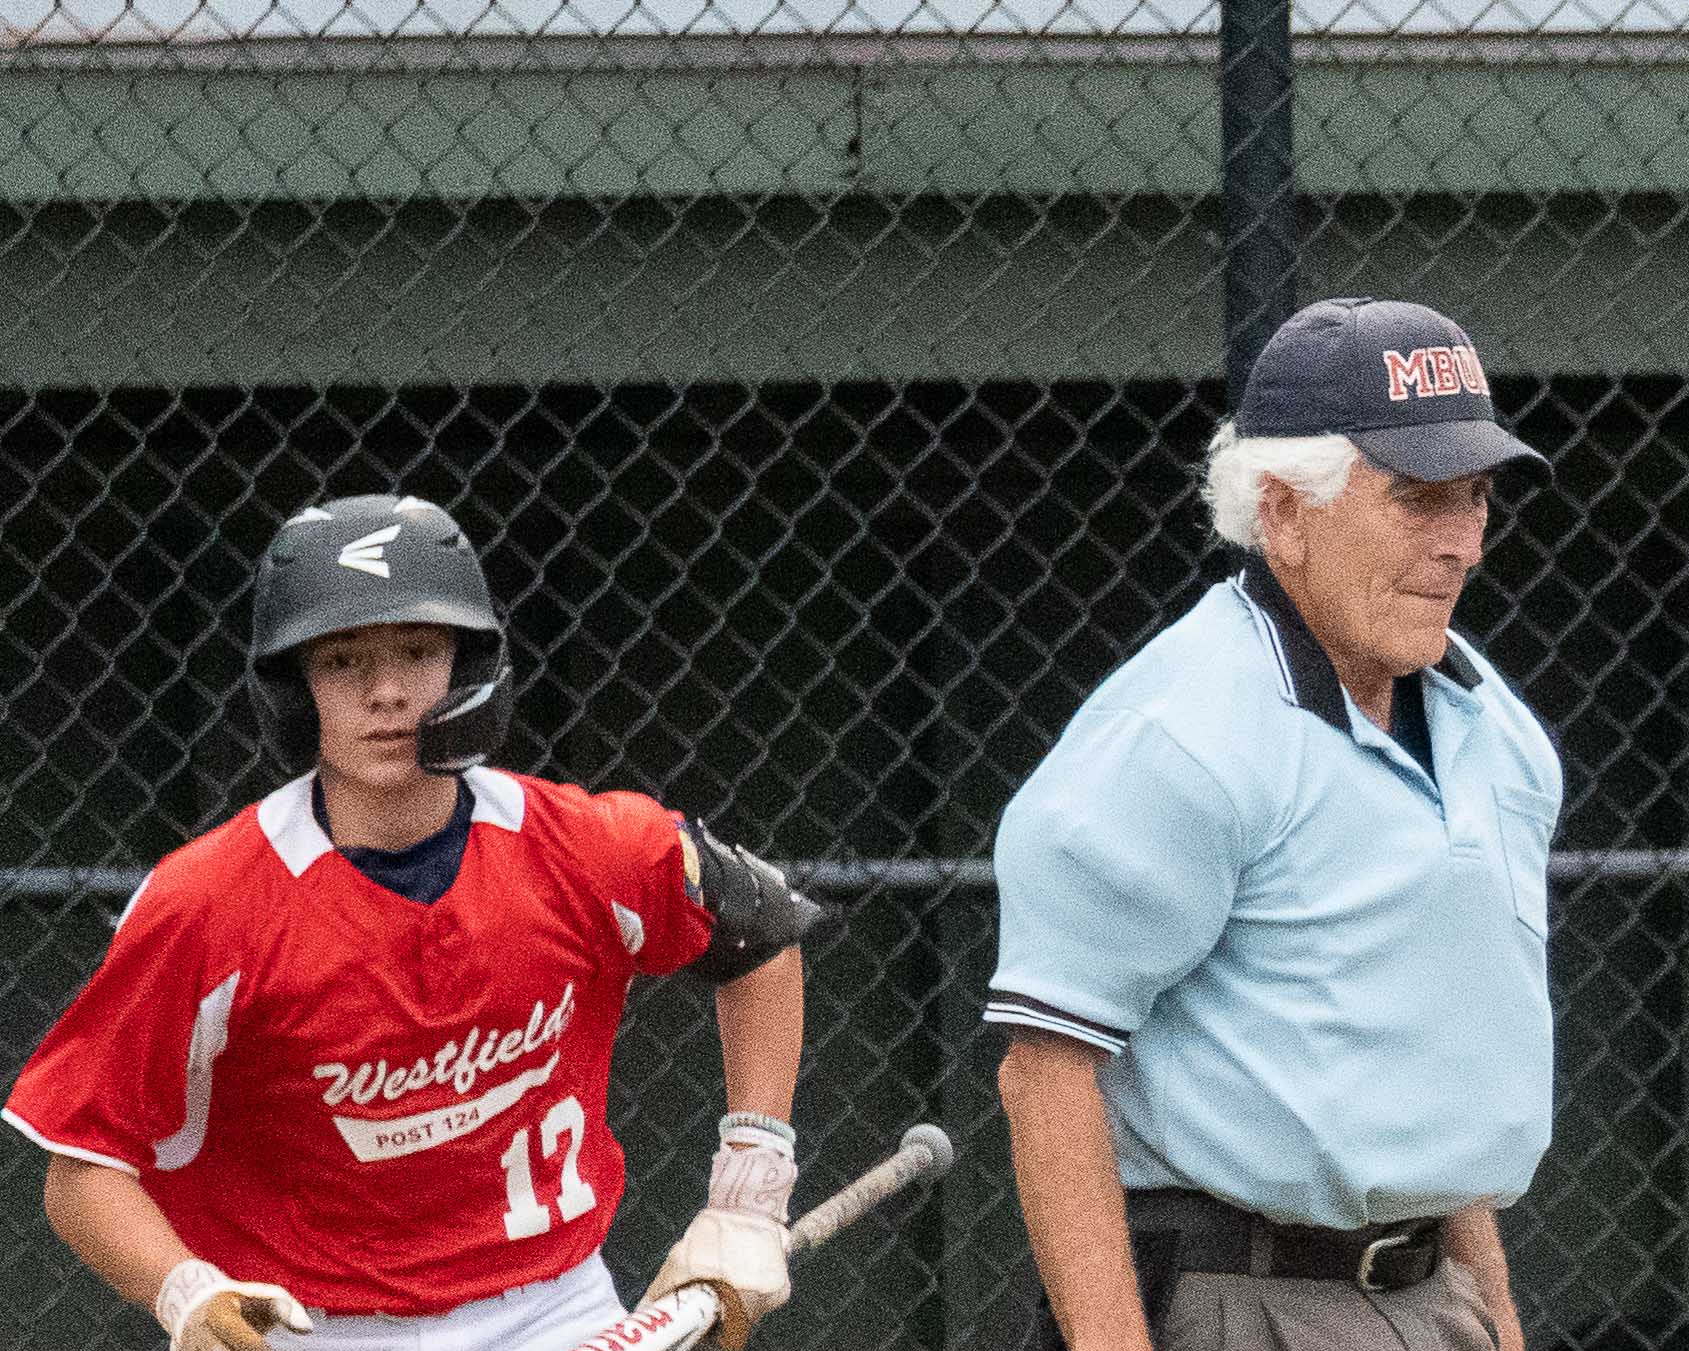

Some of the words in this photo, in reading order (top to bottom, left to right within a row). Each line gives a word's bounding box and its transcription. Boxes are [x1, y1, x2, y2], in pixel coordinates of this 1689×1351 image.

[313, 982, 575, 1104] Westfield
[375, 1122, 434, 1149] POST
[444, 1106, 481, 1132] 124
